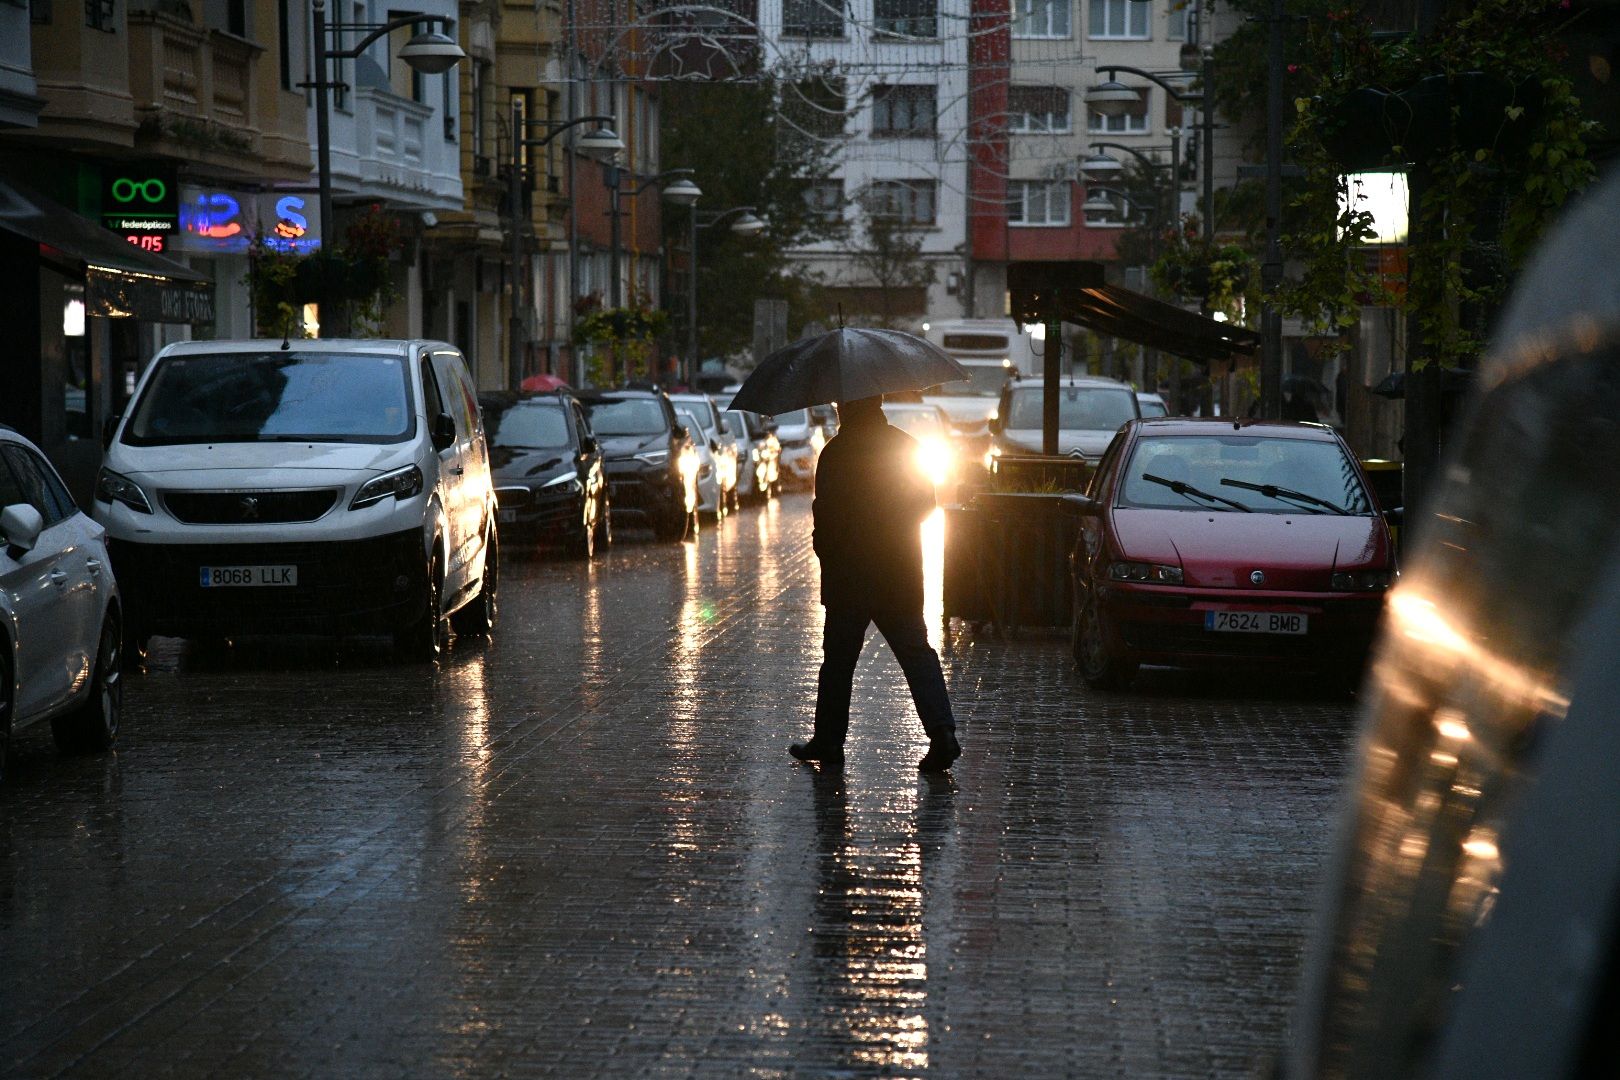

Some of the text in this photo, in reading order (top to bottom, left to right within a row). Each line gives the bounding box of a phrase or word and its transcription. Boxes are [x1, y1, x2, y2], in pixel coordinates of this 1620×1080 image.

[121, 219, 172, 230] federópticos
[213, 567, 291, 584] 8068 LLK
[1218, 613, 1300, 632] 7624 BMB
